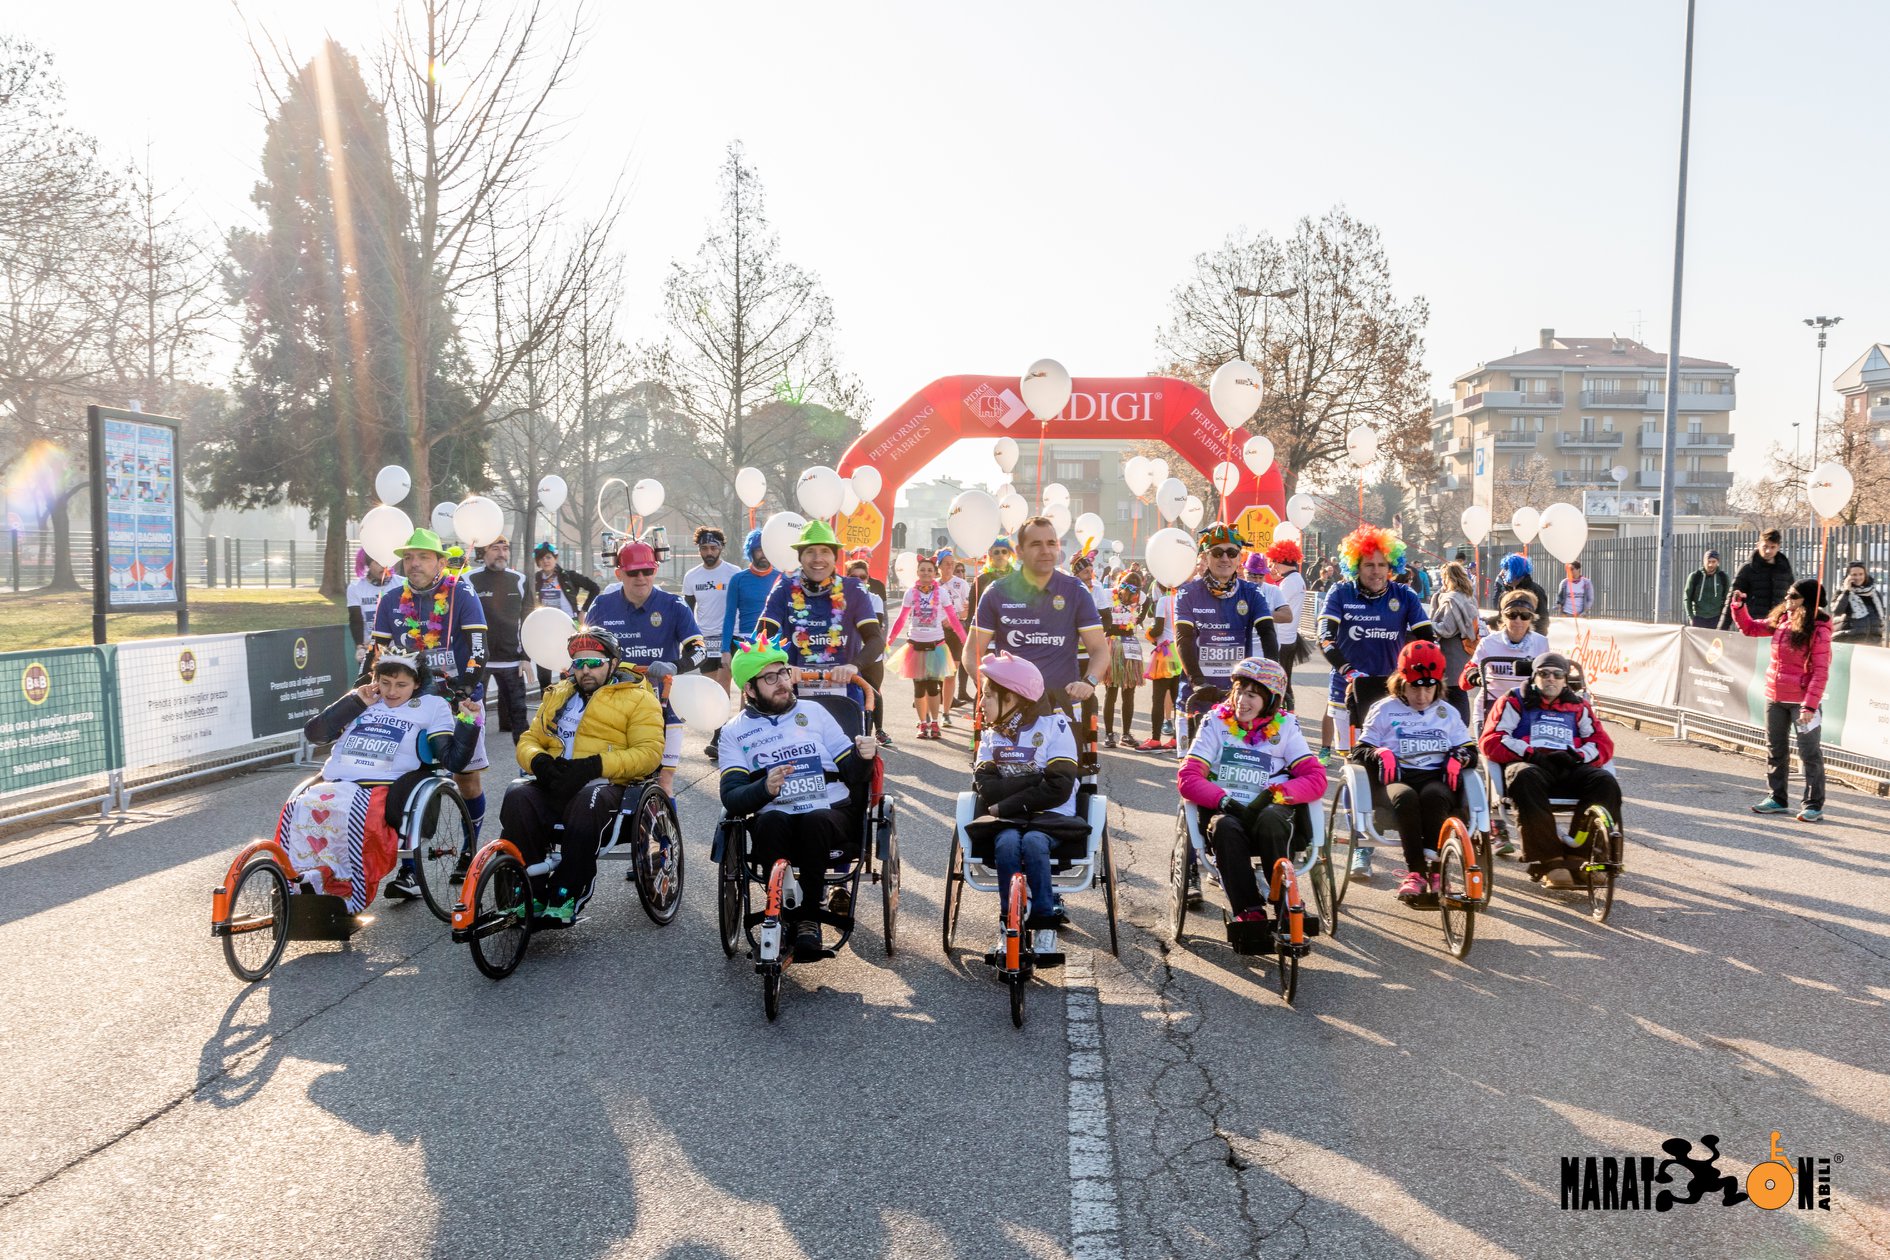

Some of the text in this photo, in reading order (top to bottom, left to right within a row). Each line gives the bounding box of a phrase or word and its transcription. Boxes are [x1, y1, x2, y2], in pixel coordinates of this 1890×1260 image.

[963, 383, 990, 407] PIDIGI
[868, 404, 934, 461] PERFORMING
[890, 425, 931, 461] FABRICS
[1193, 428, 1230, 463] FABRIC
[846, 525, 871, 538] ZERO
[1025, 633, 1065, 646] Sinergy
[1365, 628, 1399, 640] Sinergy
[625, 647, 664, 658] Sinergy
[1209, 648, 1235, 660] 3811
[26, 675, 47, 690] B&B
[372, 713, 414, 732] Sinergy
[737, 727, 763, 742] macron
[1540, 725, 1565, 738] 3813
[354, 737, 388, 753] F1607
[771, 742, 817, 762] Sinergy
[1409, 739, 1440, 752] F1602
[1233, 752, 1260, 762] Gensan
[1228, 766, 1260, 784] F1600
[781, 777, 815, 796] 3935
